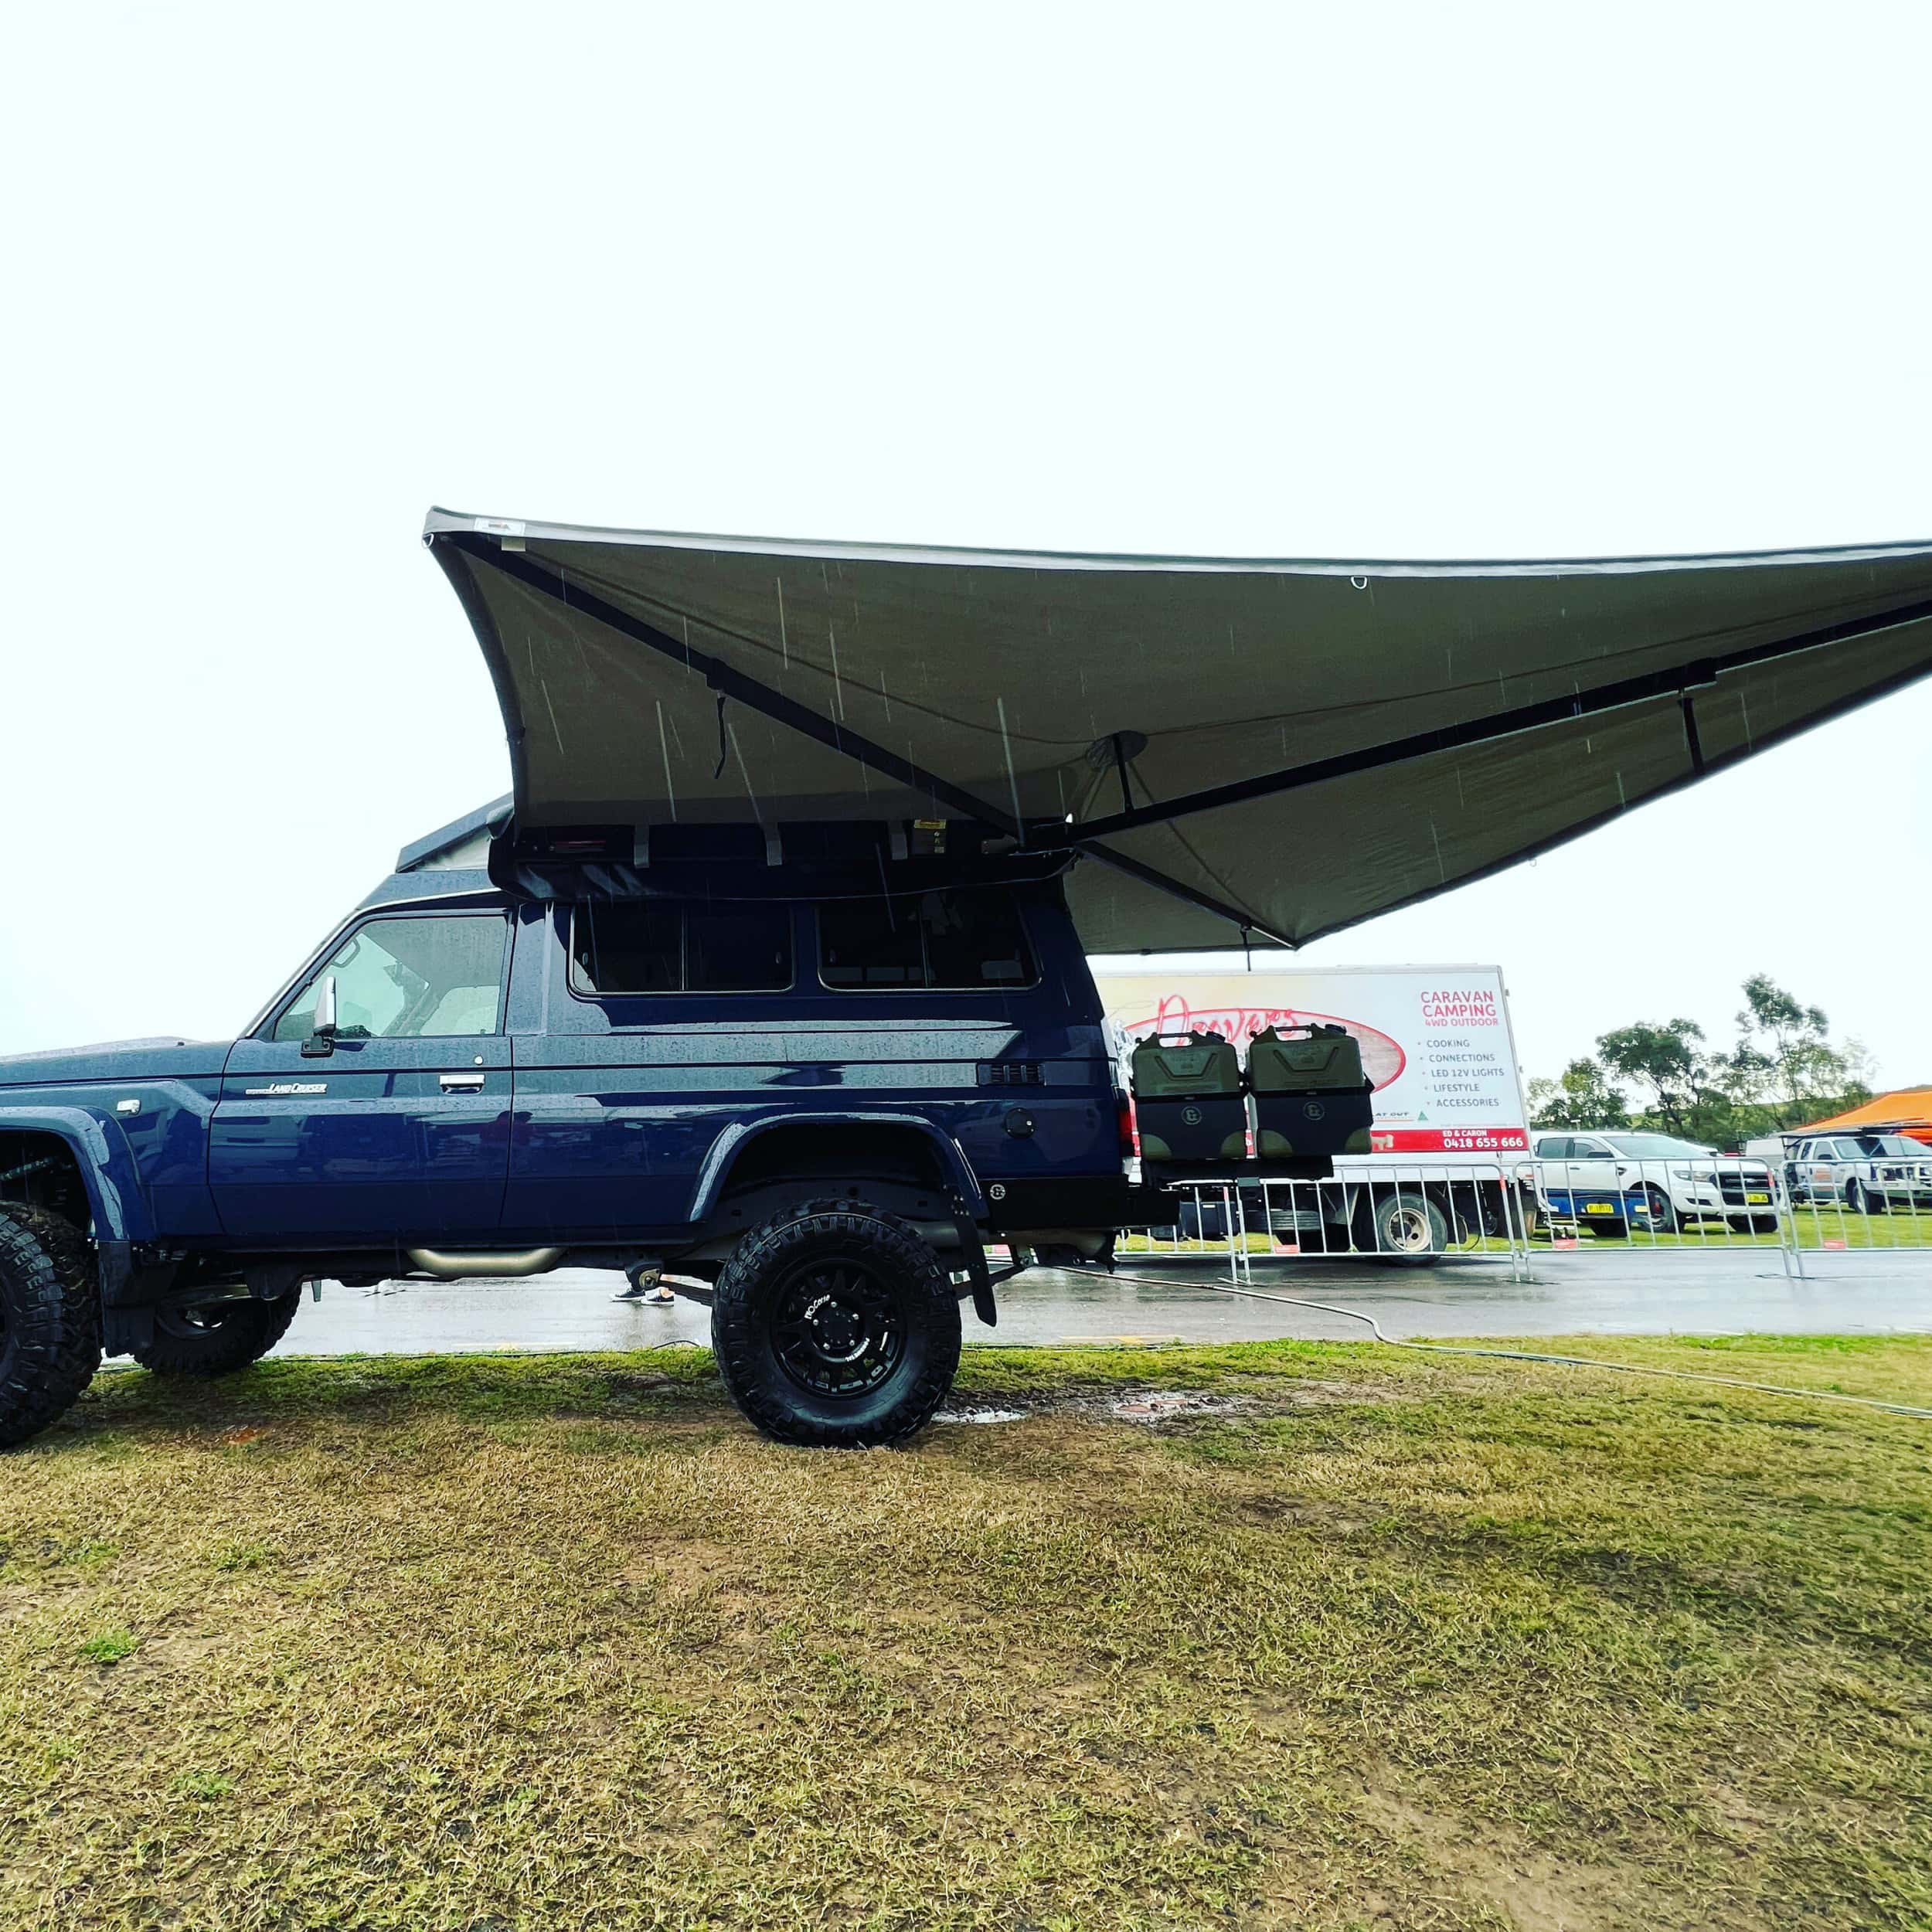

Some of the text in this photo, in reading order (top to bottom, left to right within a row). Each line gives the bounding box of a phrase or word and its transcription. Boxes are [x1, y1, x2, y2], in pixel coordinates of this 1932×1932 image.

[1420, 991, 1494, 1003] CARAVAN
[1422, 1005, 1496, 1017] CAMPING
[1425, 1018, 1498, 1027] 4WD OUTDOOR
[1427, 1039, 1470, 1048] COOKING
[1429, 1054, 1495, 1063] CONNECTIONS
[1472, 1068, 1505, 1077] LIGHTS
[1436, 1099, 1499, 1107] ACCESSORIES
[1444, 1138, 1523, 1148] 0418 655 666
